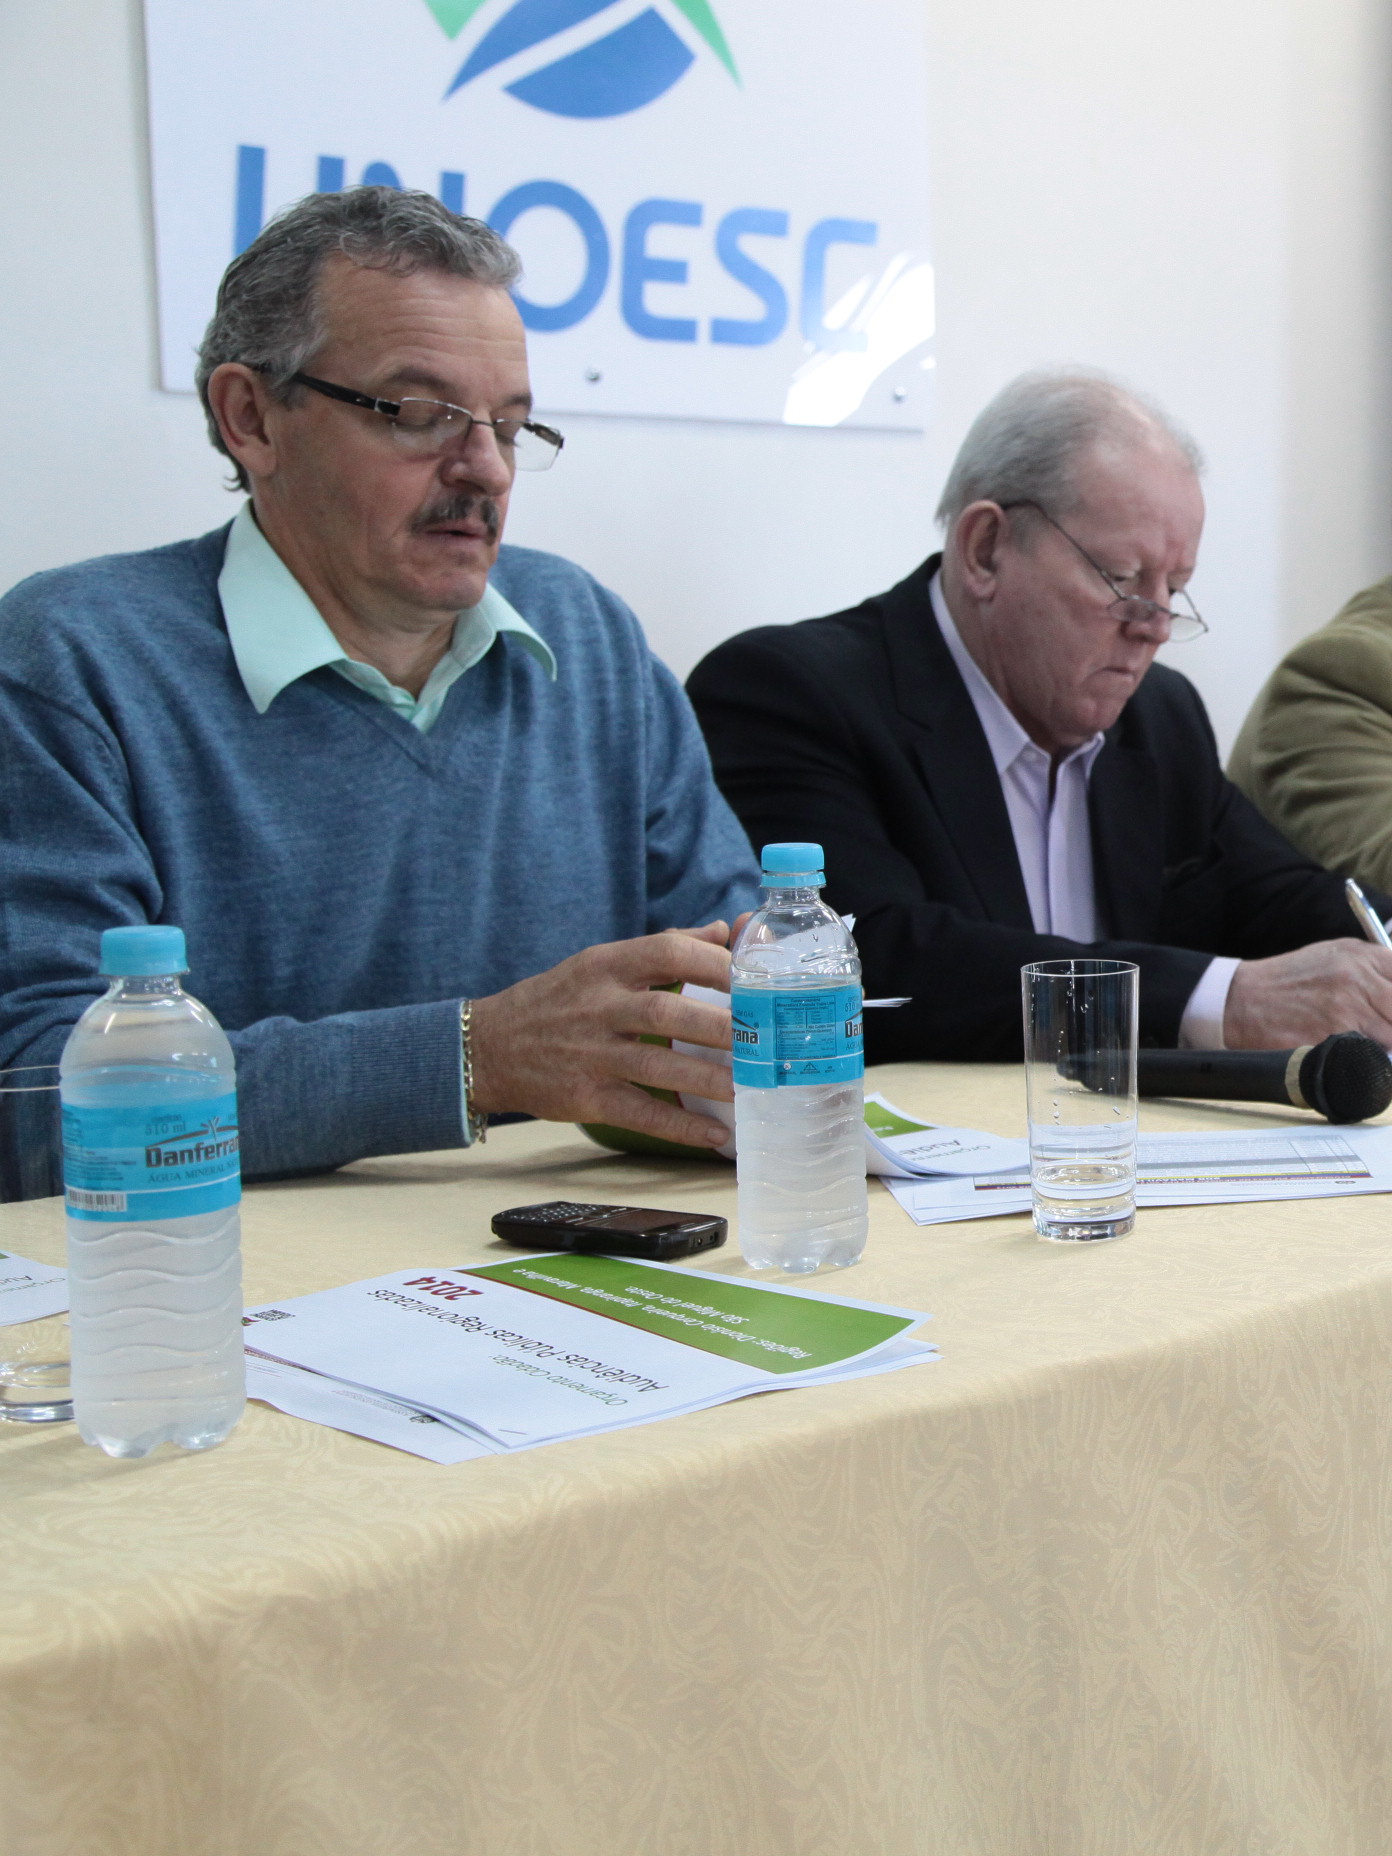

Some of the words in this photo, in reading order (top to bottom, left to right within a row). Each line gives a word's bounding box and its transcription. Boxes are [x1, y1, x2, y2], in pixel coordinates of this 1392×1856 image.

[184, 1164, 226, 1180] MINERAL
[403, 1276, 484, 1301] 2014
[367, 1288, 494, 1333] Regionalizadas
[485, 1328, 562, 1358] Públicas
[557, 1353, 669, 1393] Audiências
[549, 1373, 628, 1406] Orçamento
